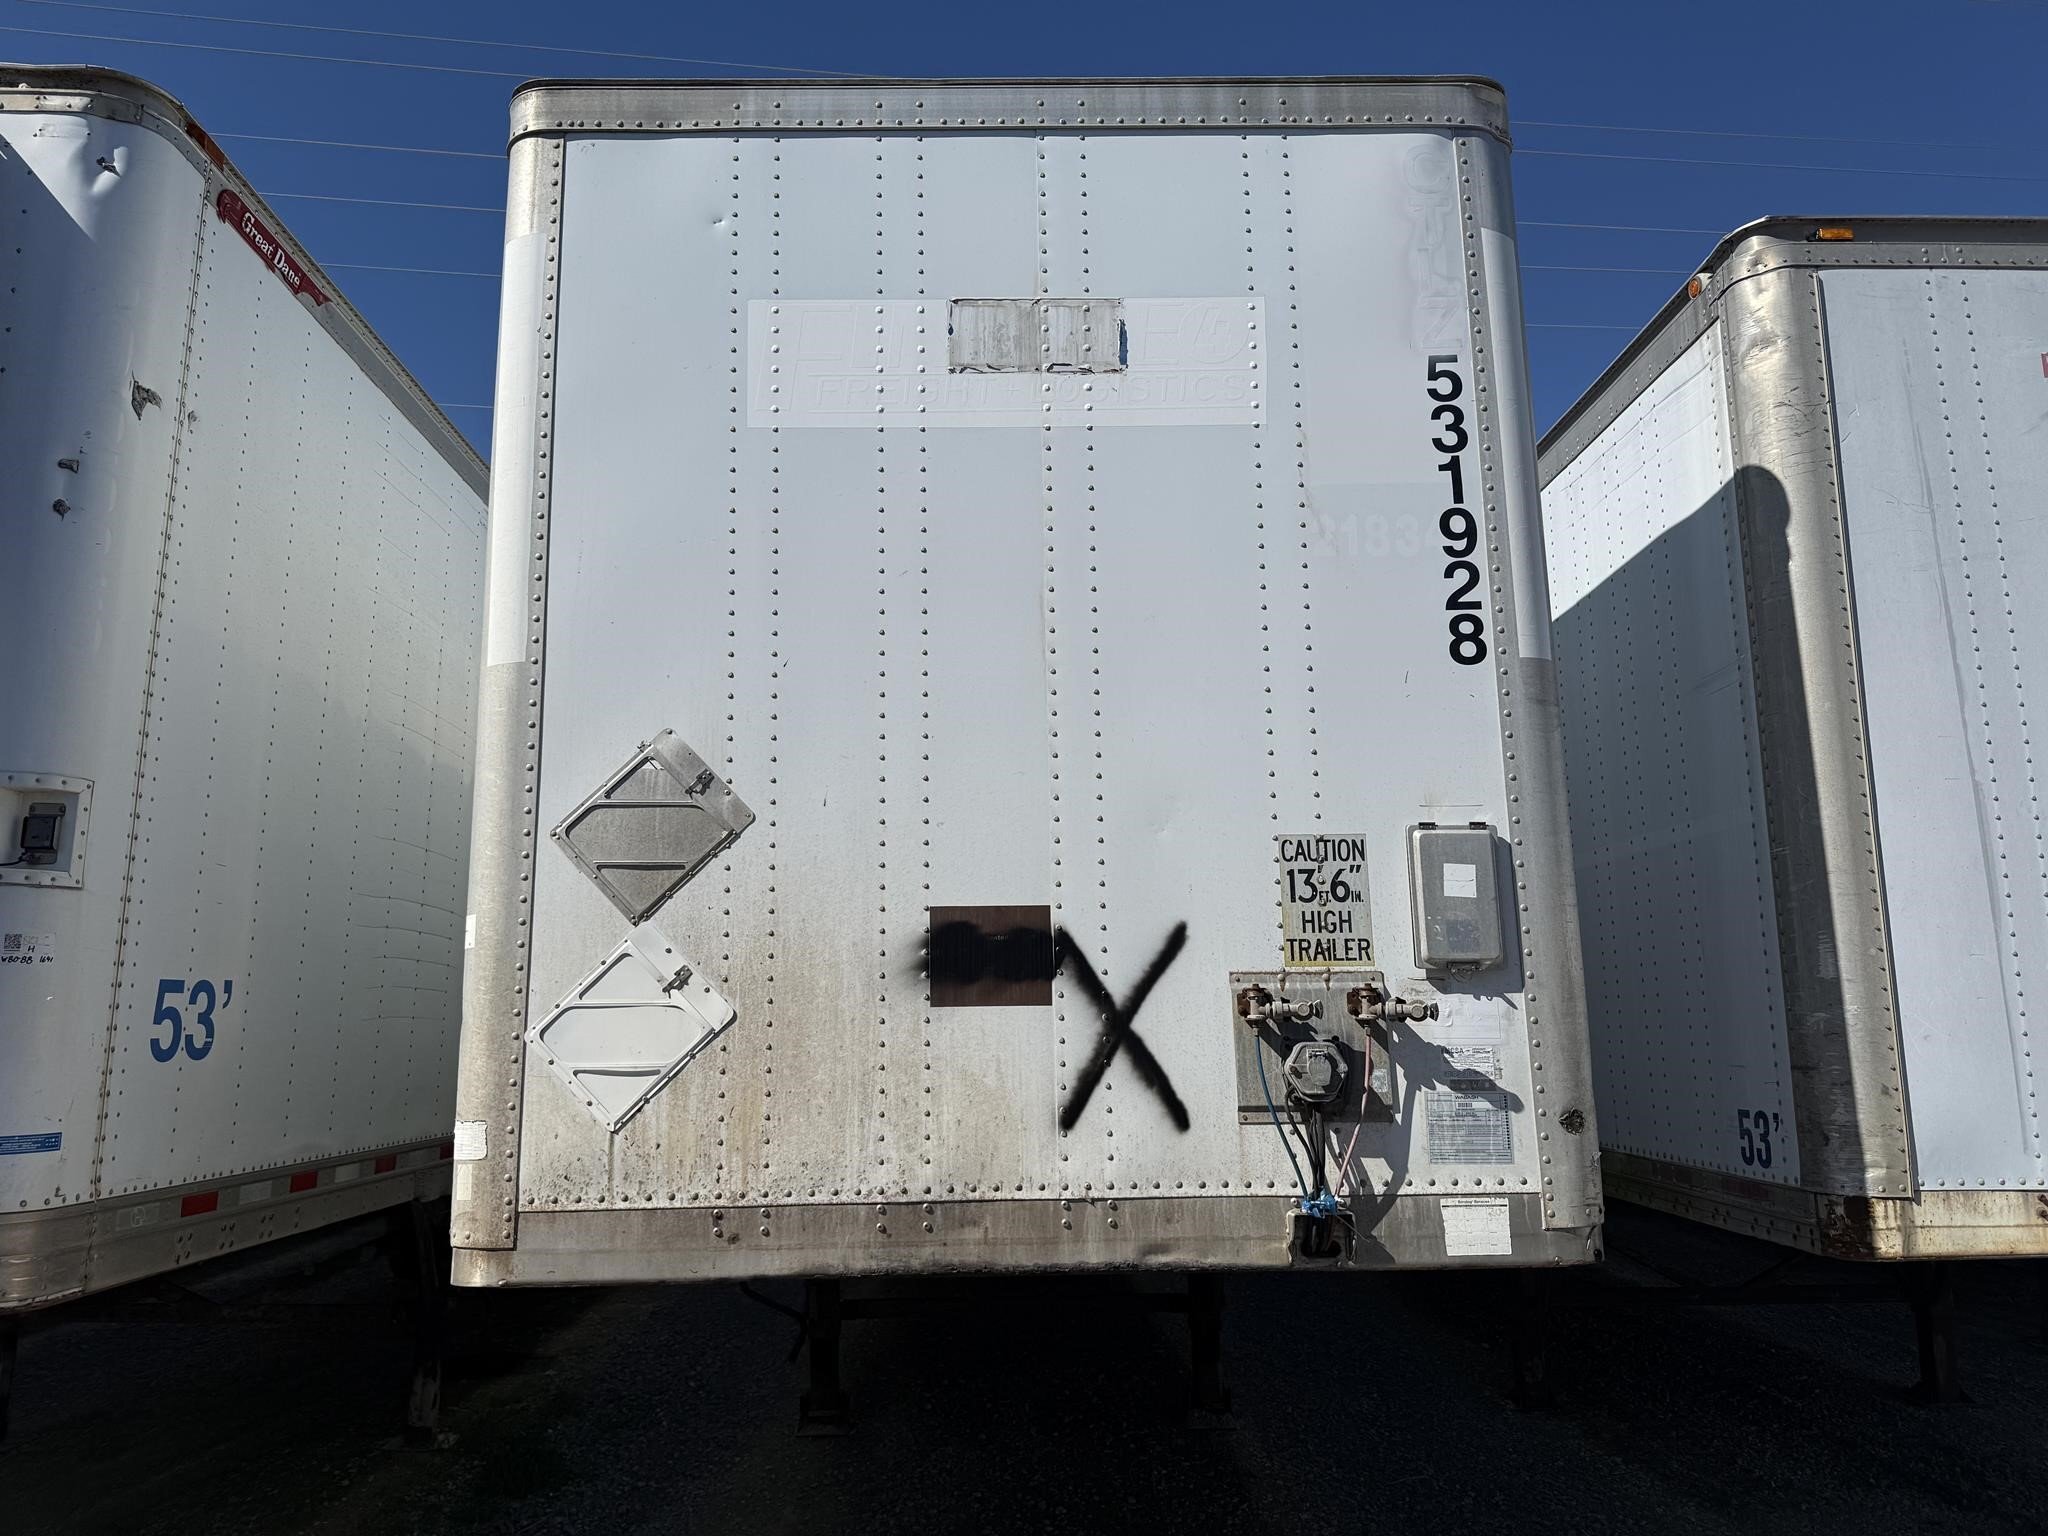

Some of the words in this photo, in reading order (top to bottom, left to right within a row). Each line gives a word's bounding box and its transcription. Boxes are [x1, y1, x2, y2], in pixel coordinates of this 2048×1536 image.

[241, 211, 275, 259] Great
[274, 248, 301, 288] Dane
[1427, 355, 1488, 666] 531928
[1281, 838, 1365, 862] CAUTION
[1286, 938, 1372, 962] TRAILER
[1302, 910, 1353, 934] HIGH
[150, 979, 233, 1063] 53'
[1737, 1108, 1780, 1170] 53'
